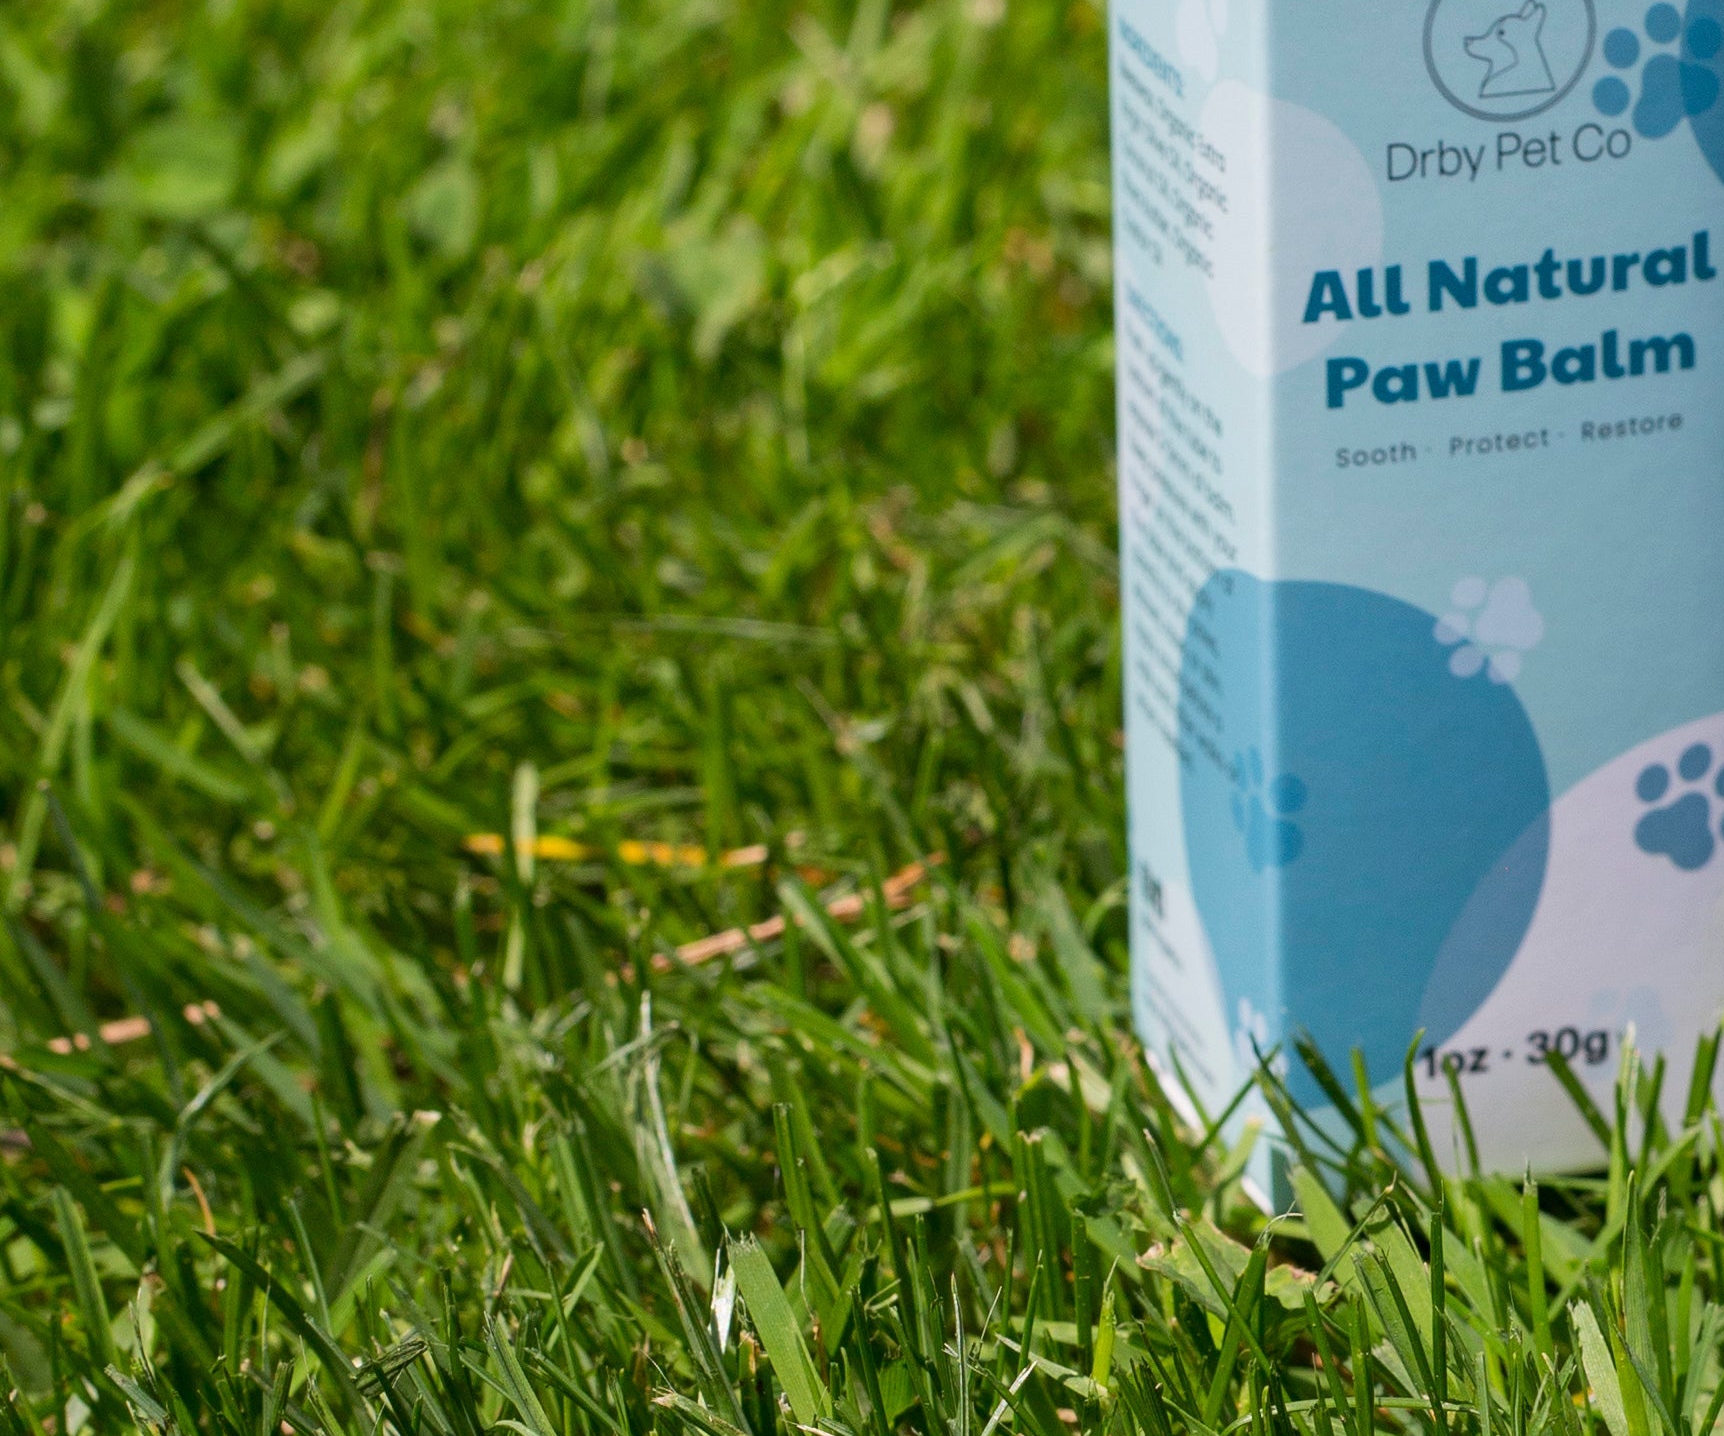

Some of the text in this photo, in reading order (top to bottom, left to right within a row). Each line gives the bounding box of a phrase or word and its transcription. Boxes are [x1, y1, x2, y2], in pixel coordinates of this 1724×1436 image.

[1386, 123, 1633, 182] Drby Pet Co
[1302, 229, 1718, 324] All Natural
[1325, 328, 1697, 409] Paw Balm
[1335, 411, 1685, 469] Sooth Protect Restore
[1419, 1026, 1609, 1078] 1oz 30g
